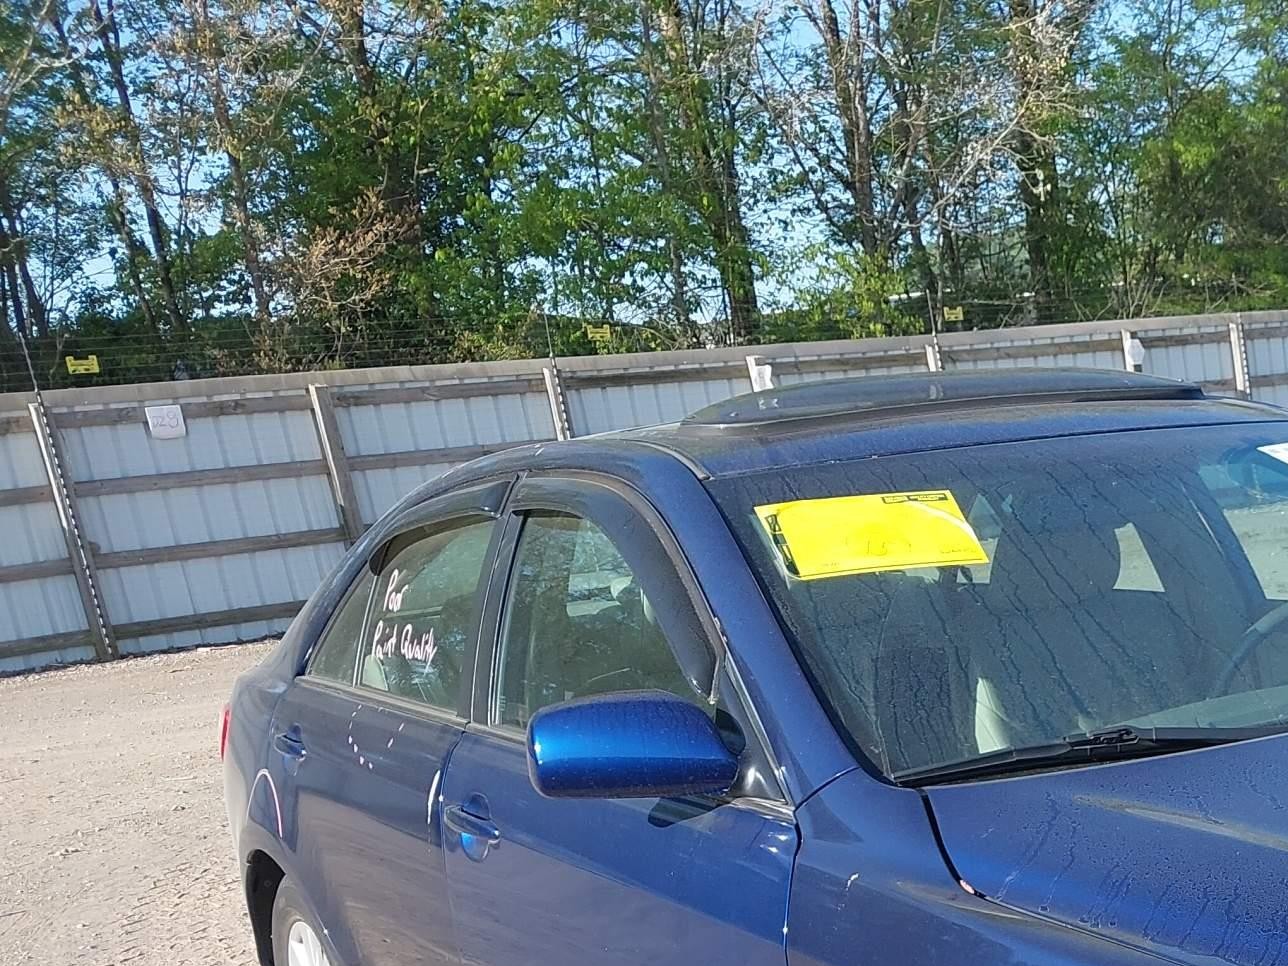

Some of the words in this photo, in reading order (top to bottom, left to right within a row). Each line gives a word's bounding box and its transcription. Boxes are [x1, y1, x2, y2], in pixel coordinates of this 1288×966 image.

[383, 569, 408, 612] Poor
[371, 620, 398, 660] Paint
[400, 624, 437, 676] Quality
